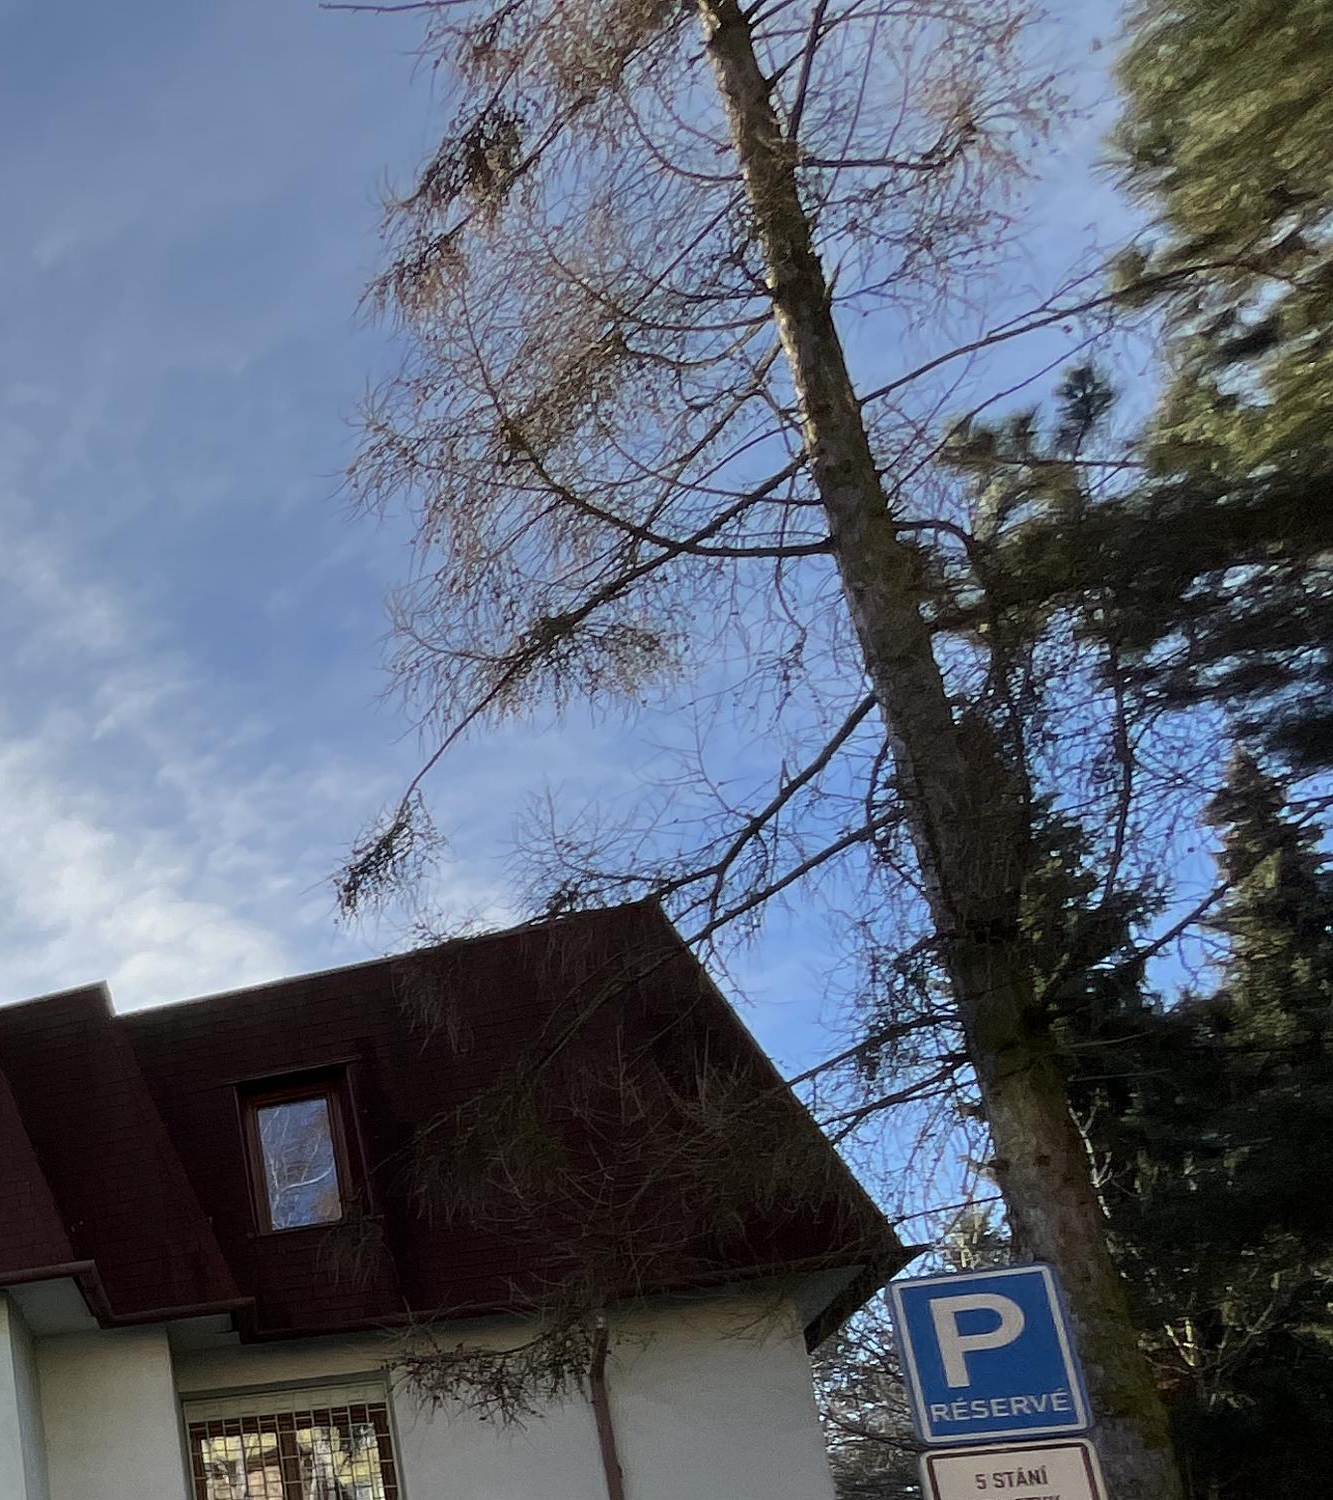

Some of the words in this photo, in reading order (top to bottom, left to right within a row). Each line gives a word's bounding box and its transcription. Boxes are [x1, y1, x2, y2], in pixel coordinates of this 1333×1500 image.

[930, 1293, 1025, 1388] P
[930, 1388, 1072, 1422] RÉSERVÉ
[975, 1473, 987, 1490] 5
[993, 1465, 1050, 1489] STÁNÍ
